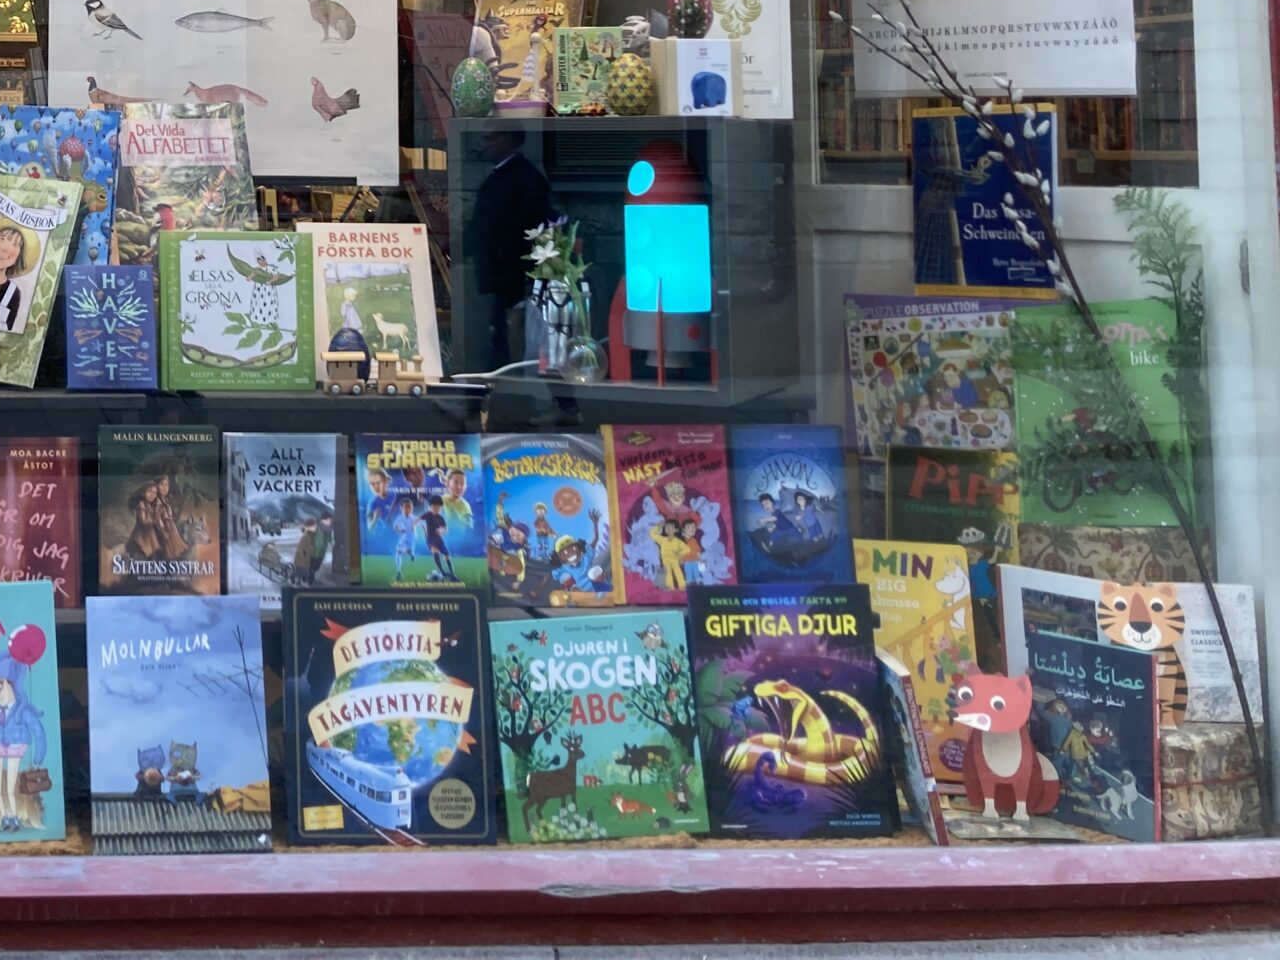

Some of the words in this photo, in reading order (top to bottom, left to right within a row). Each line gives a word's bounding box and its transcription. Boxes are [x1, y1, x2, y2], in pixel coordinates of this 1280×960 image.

[135, 124, 156, 137] Det
[157, 122, 186, 137] Vilda
[126, 131, 230, 155] ALFABETET
[972, 201, 998, 219] Das
[328, 231, 400, 245] BARNENS
[317, 244, 377, 259] FÖRSTA
[380, 245, 414, 259] BOK
[190, 269, 235, 283] ELSAS
[185, 289, 242, 304] GRÖNA
[904, 300, 980, 316] OBSERVATION
[101, 272, 119, 381] HAVET
[1129, 349, 1160, 367] bike
[113, 433, 144, 442] MALIN
[146, 432, 213, 442] KLINGENBERG
[9, 448, 33, 458] MOA
[35, 448, 68, 458] BACKE
[270, 448, 304, 460] ALLT
[23, 459, 55, 470] ÅSTOT
[258, 463, 292, 477] SOM
[297, 460, 316, 477] ÄR
[622, 460, 663, 485] NÄST
[18, 480, 58, 500] DET
[253, 479, 322, 493] VACKERT
[29, 511, 56, 529] OM
[33, 540, 69, 570] JAG
[112, 554, 167, 576] SLÄTTENS
[169, 559, 215, 576] SYSTRAR
[875, 578, 907, 593] BIG
[705, 613, 794, 638] GIFTIGA
[797, 613, 858, 637] DJUR
[100, 632, 211, 669] MOLNBULLAR
[340, 640, 362, 663] DE
[553, 639, 619, 658] DJUREN
[529, 654, 658, 692] SKOGEN
[315, 692, 464, 732] TÅGÄVENTYREN
[570, 692, 627, 726] ABC
